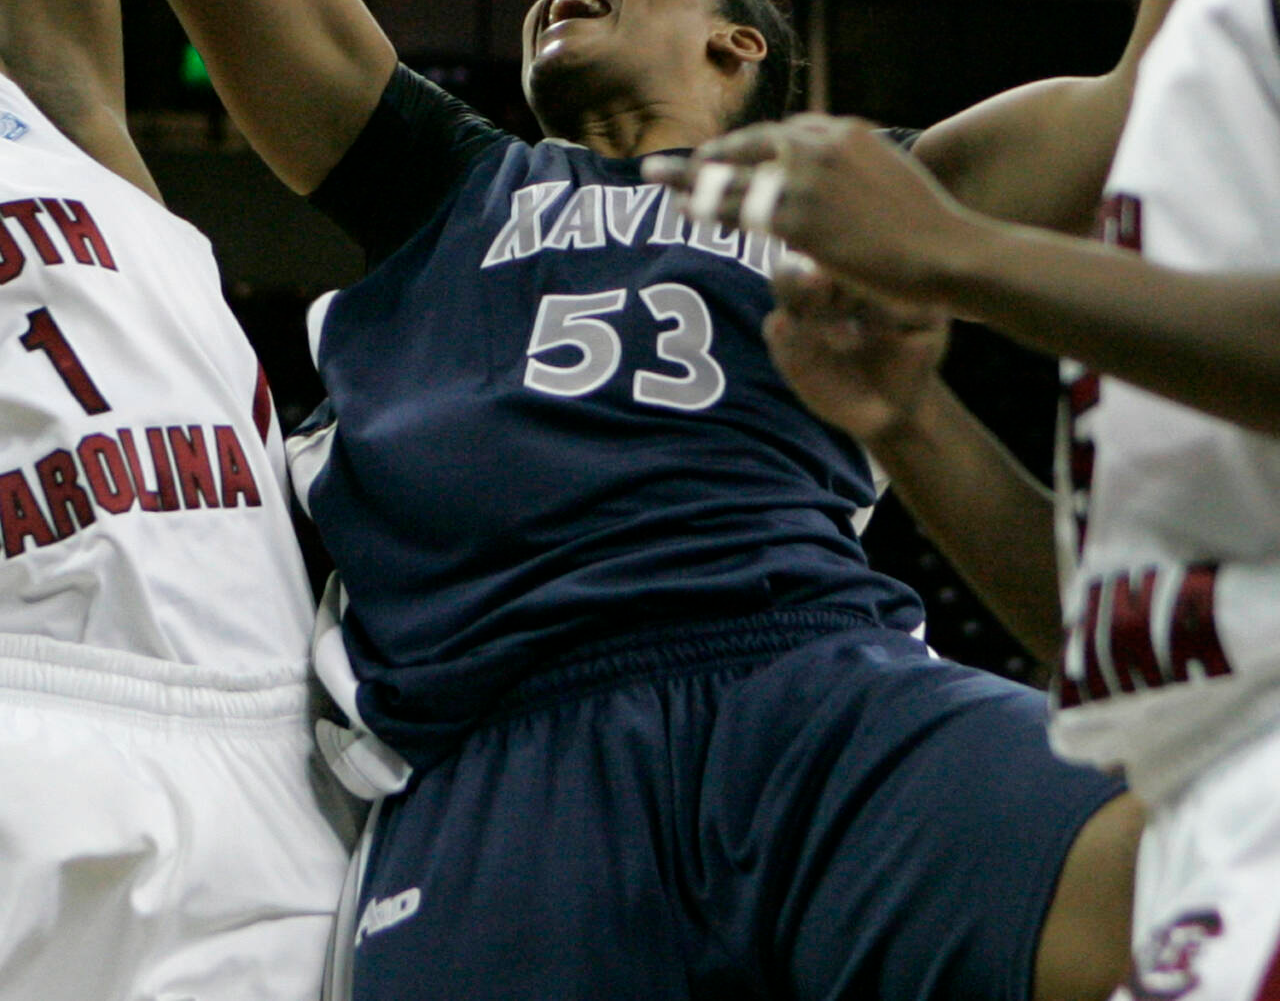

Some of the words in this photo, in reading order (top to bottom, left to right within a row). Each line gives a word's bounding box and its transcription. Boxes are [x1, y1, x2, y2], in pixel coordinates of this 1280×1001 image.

[480, 180, 788, 280] XAVIE
[19, 305, 113, 416] 1
[523, 282, 727, 411] 53
